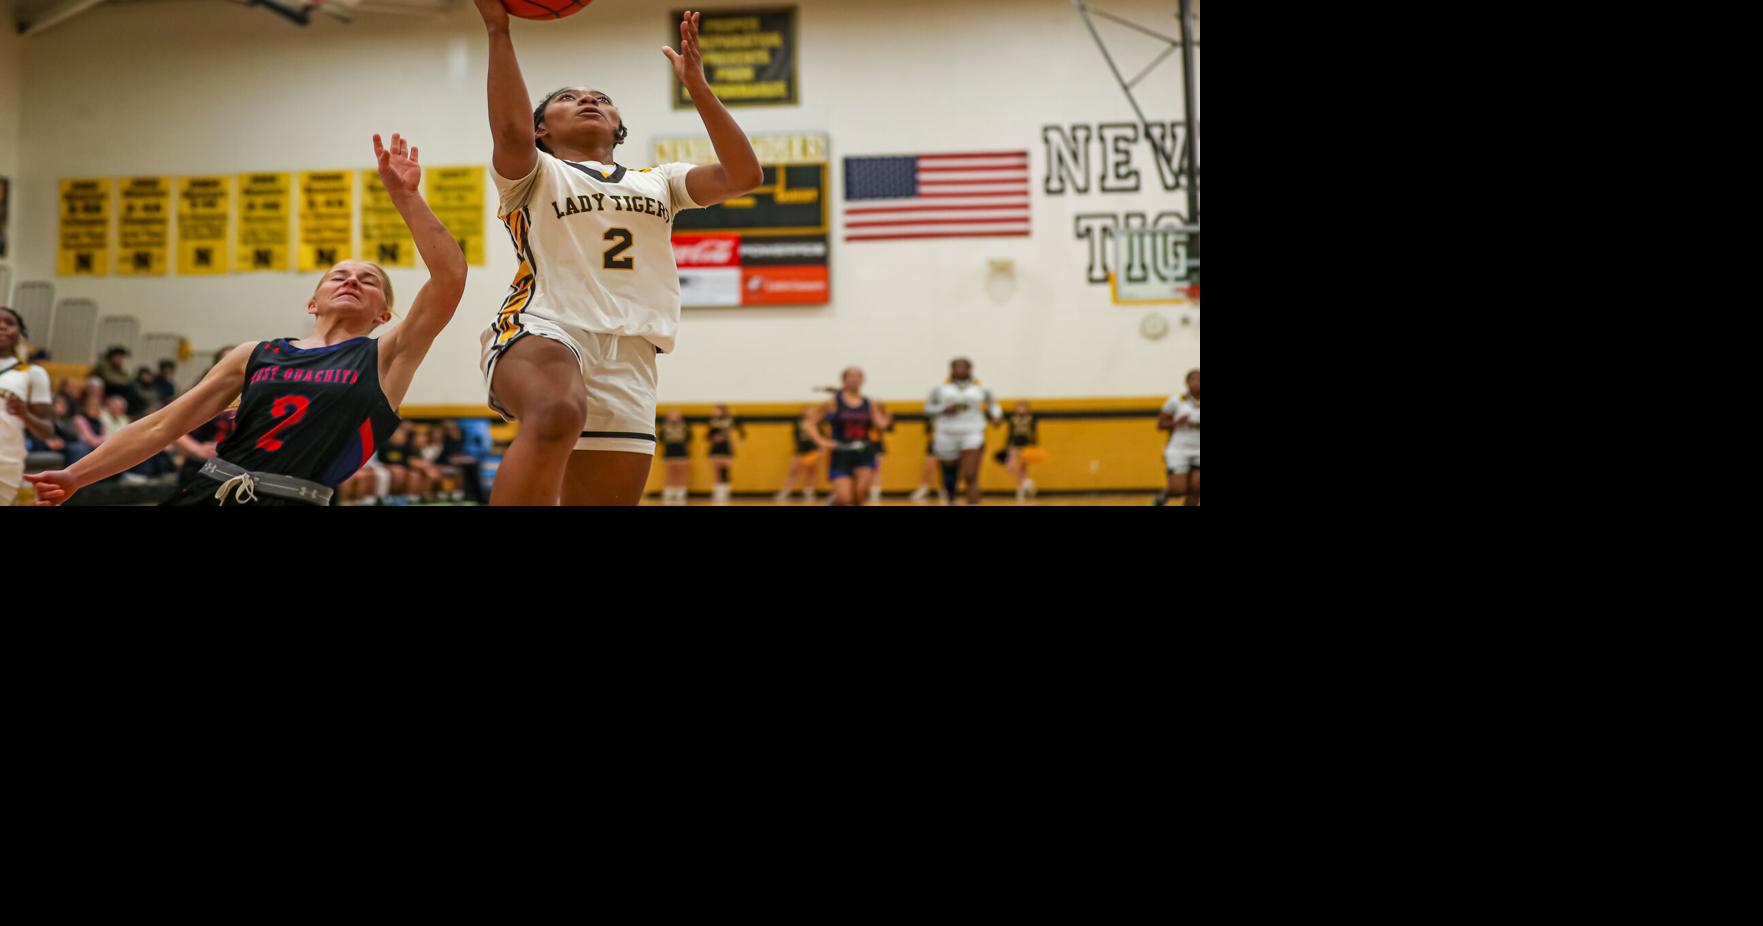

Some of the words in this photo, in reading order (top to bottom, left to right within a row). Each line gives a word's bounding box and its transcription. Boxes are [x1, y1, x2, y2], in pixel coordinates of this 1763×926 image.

[1043, 122, 1199, 195] NEV
[552, 192, 605, 219] LADY
[602, 226, 635, 271] 2
[1075, 212, 1199, 283] TIG
[255, 394, 310, 452] 2
